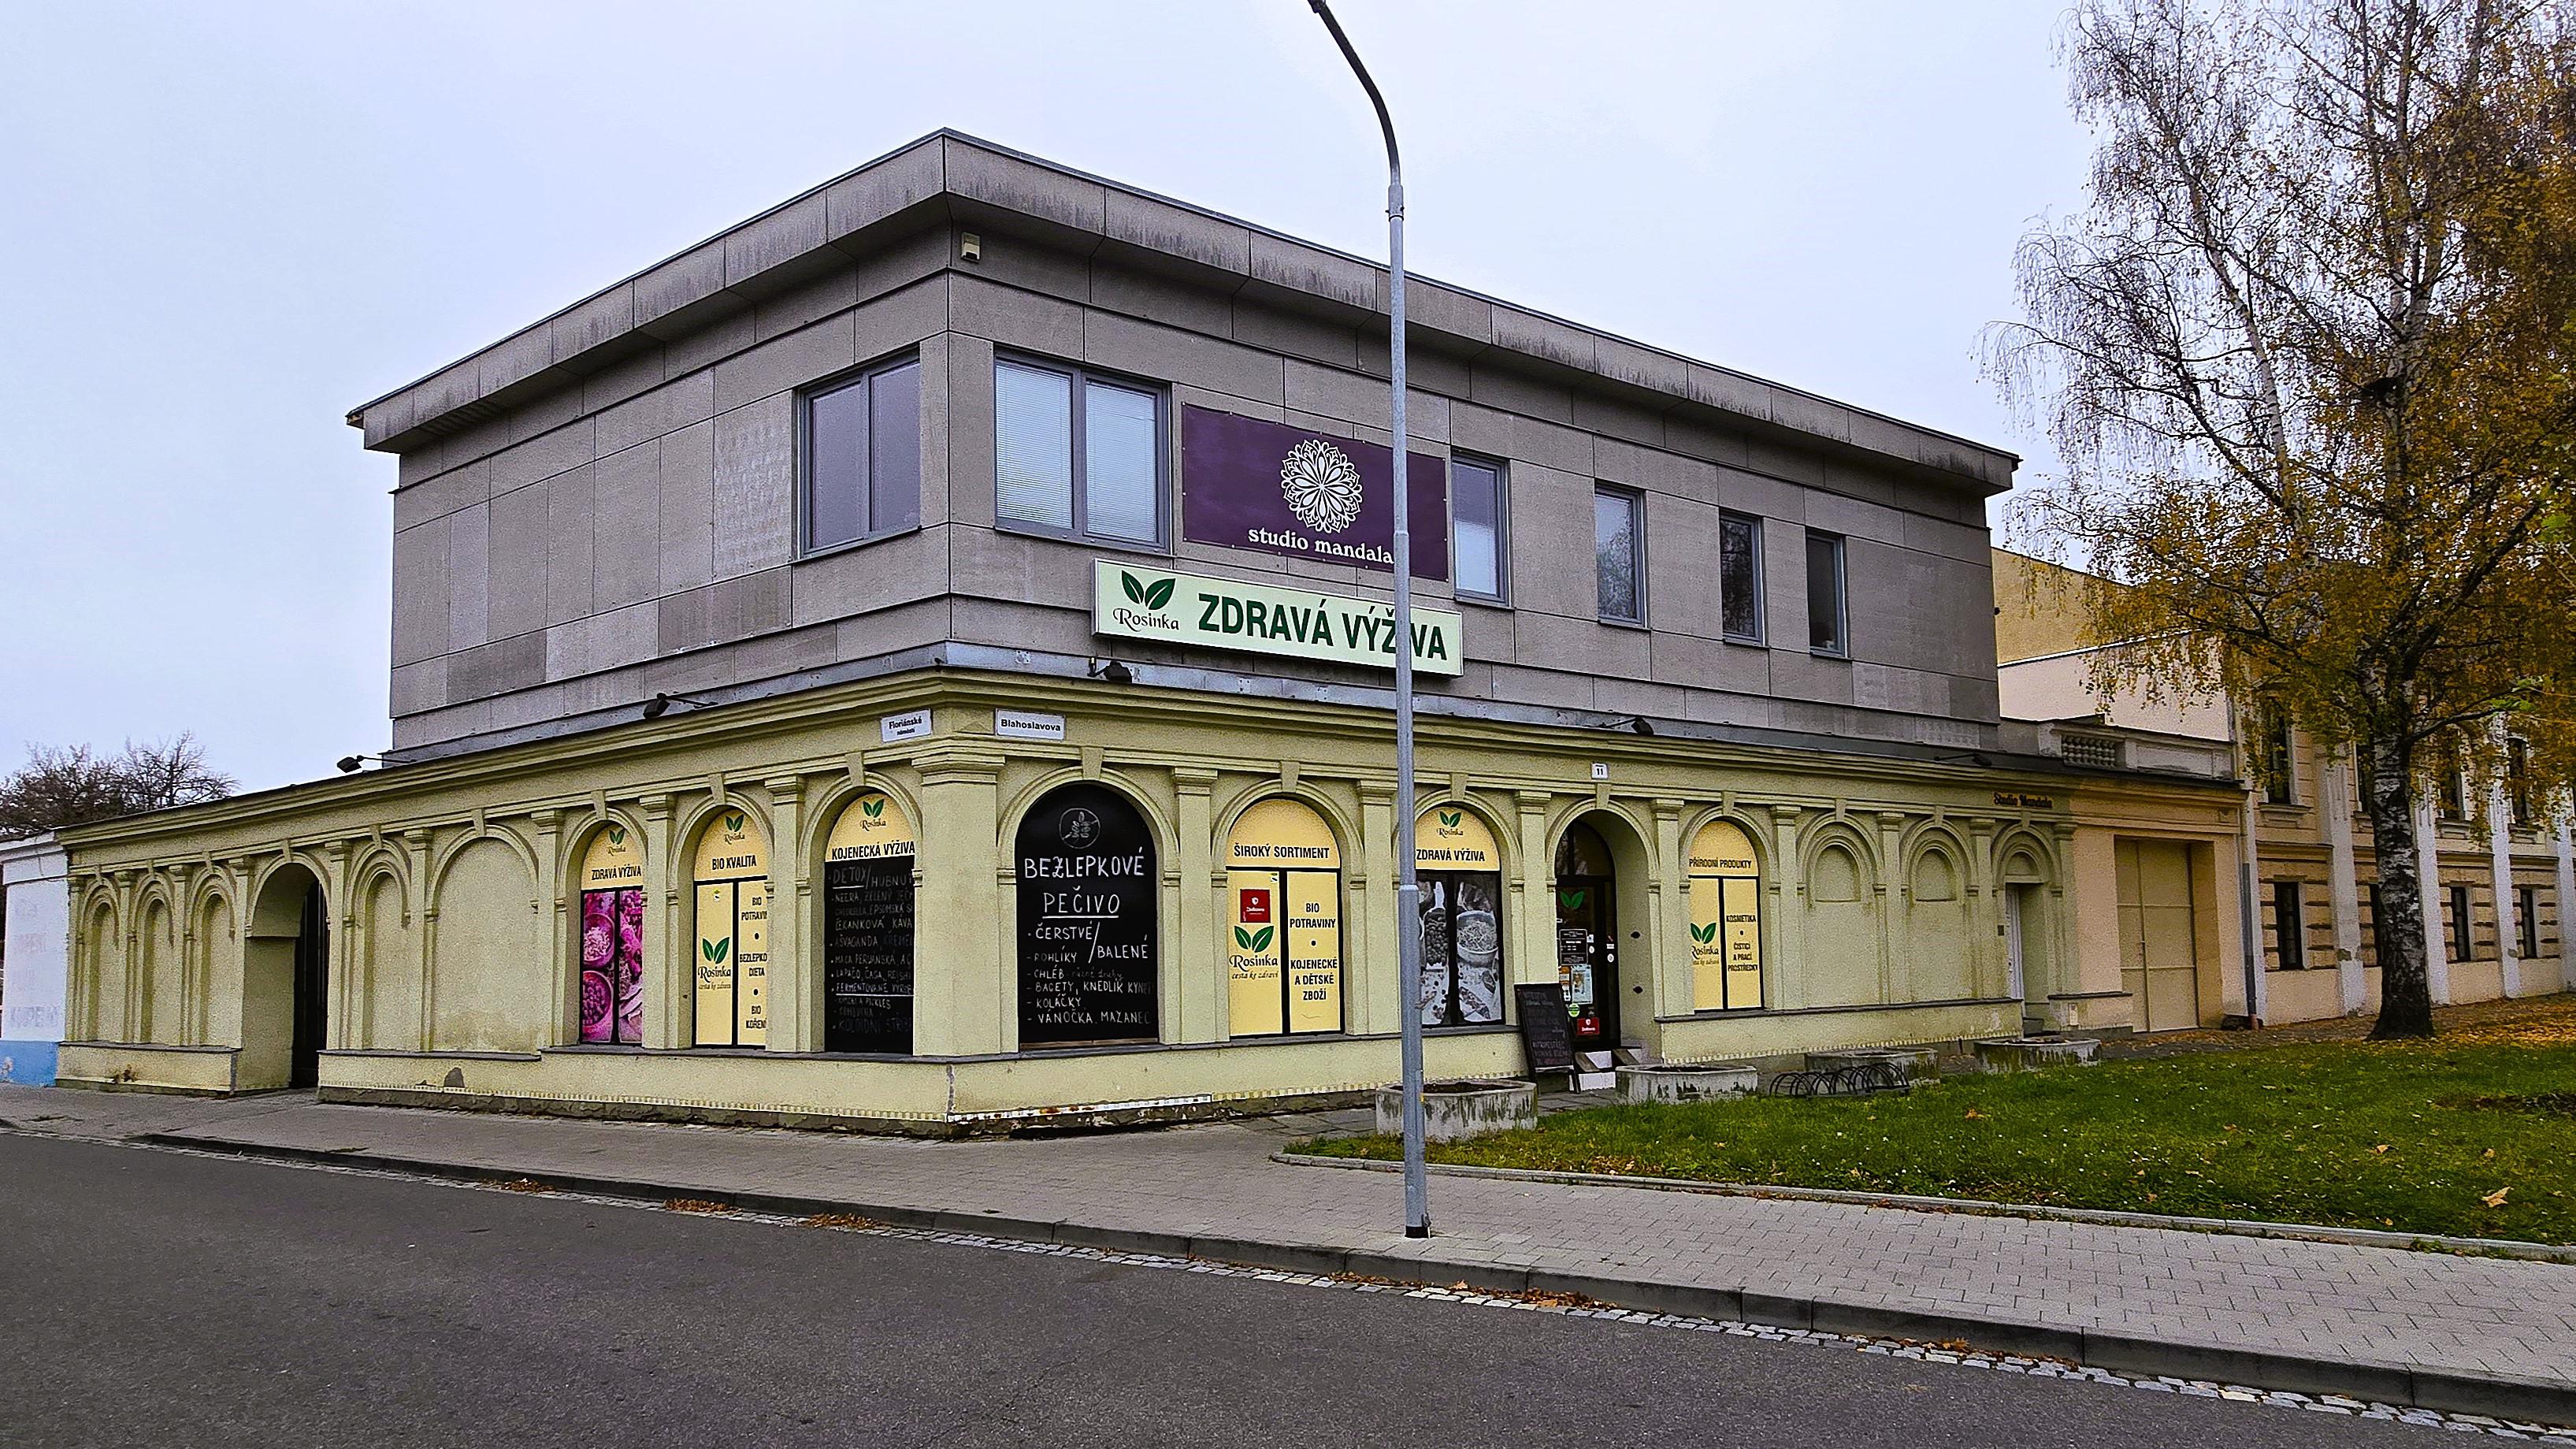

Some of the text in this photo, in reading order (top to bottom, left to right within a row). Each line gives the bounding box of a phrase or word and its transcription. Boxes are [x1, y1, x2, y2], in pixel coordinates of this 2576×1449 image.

[1248, 526, 1394, 564] studio mandala
[1112, 607, 1179, 632] Rosinka
[1198, 593, 1447, 661] ZDRAVÁ VÝŽVA
[889, 715, 922, 730] Floriánské
[1000, 719, 1062, 732] Blahoslavova
[832, 839, 915, 860] KOJENECKÁ VÝŽIVA
[1234, 842, 1330, 859] ŠIROKÝ SORTIMENT
[1416, 847, 1486, 862] ZDRAVÁ VÝŽIVA
[711, 854, 757, 871] BIO KVALITA
[1024, 846, 1145, 879] BEZLEPKOVÉ
[592, 864, 642, 881] ZDRAVÁ VÝŽIVA
[752, 897, 762, 906] BIO
[1044, 885, 1120, 914] PEČIVO
[1305, 902, 1320, 913] BIO
[1290, 918, 1336, 928] POTRAVINY
[1726, 914, 1757, 923] KOSMETIKA
[1097, 934, 1149, 959] BALENÉ
[1228, 953, 1279, 972] Rosinka
[1290, 956, 1338, 970] KOJENECKÉ
[1738, 952, 1753, 960] PRACÍ
[697, 964, 732, 983] Rosinka
[748, 968, 766, 977] DIETA
[1034, 964, 1064, 979] CHLÉB
[1294, 972, 1334, 985] A DĚTSKÉ
[1083, 978, 1124, 995] KNEDLÍK
[1302, 988, 1327, 1001] ZBOŽÍ
[1101, 1010, 1152, 1024] MAZANEC
